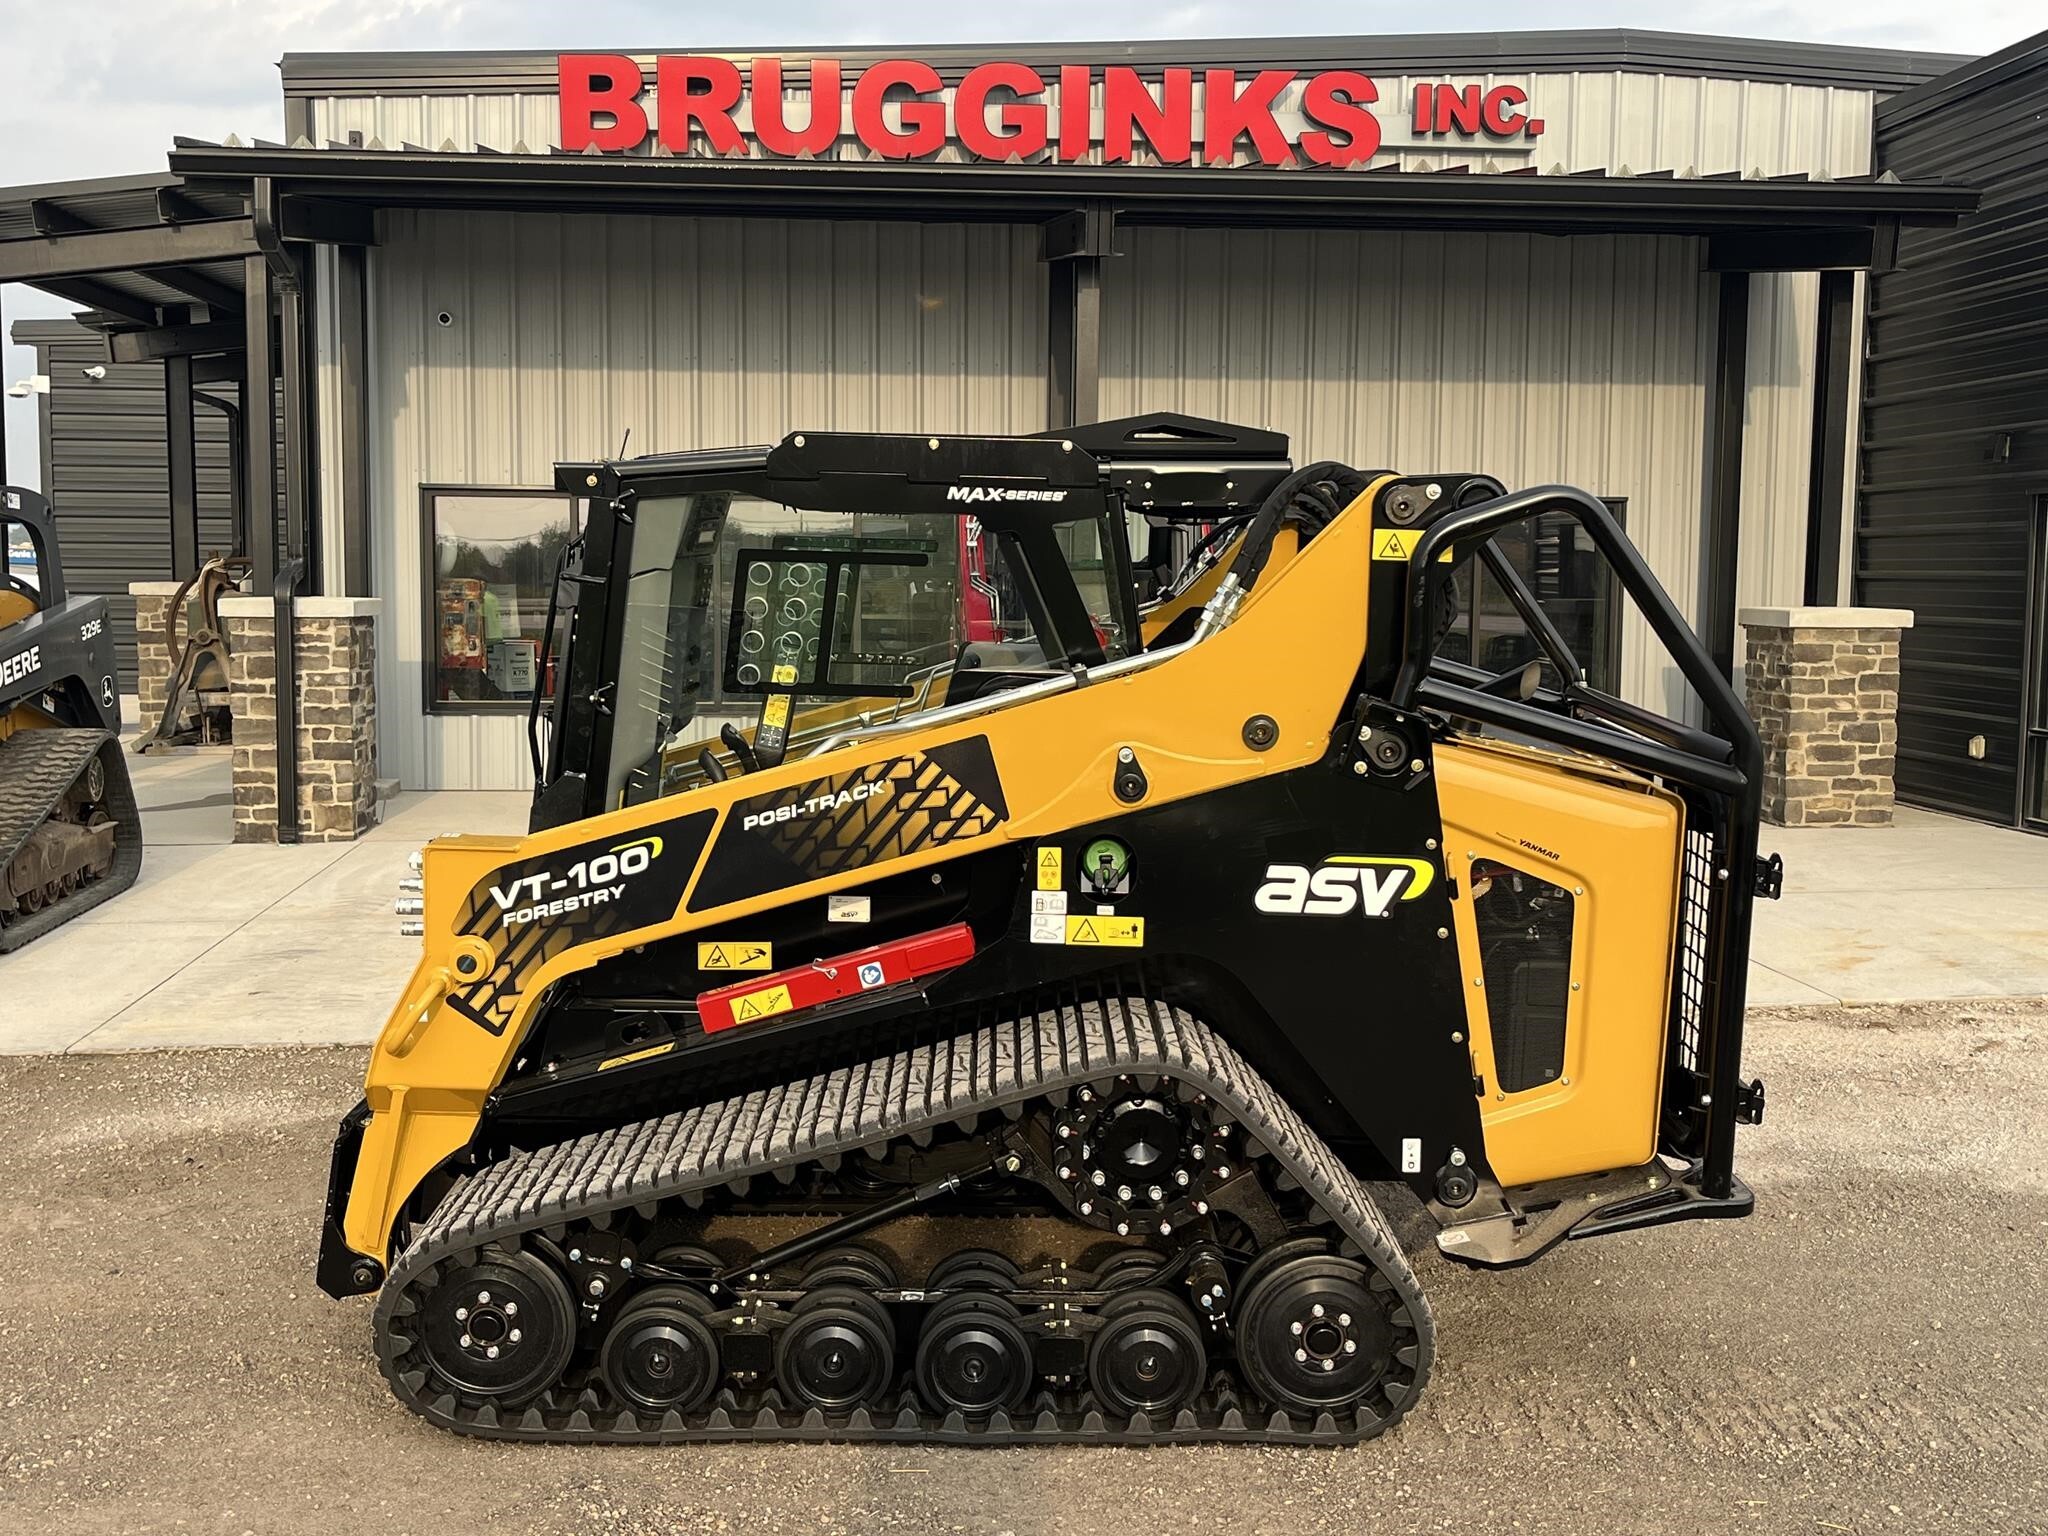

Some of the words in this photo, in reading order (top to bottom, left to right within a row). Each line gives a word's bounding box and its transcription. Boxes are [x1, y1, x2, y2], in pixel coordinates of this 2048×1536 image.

[558, 53, 1381, 168] BRUGGINKS
[1413, 84, 1545, 136] INC.
[80, 619, 102, 641] 329E
[743, 780, 886, 831] POSI-TRACK
[1519, 838, 1560, 861] YANMAR
[488, 846, 650, 910] VT-100
[502, 883, 626, 928] FORESTRY
